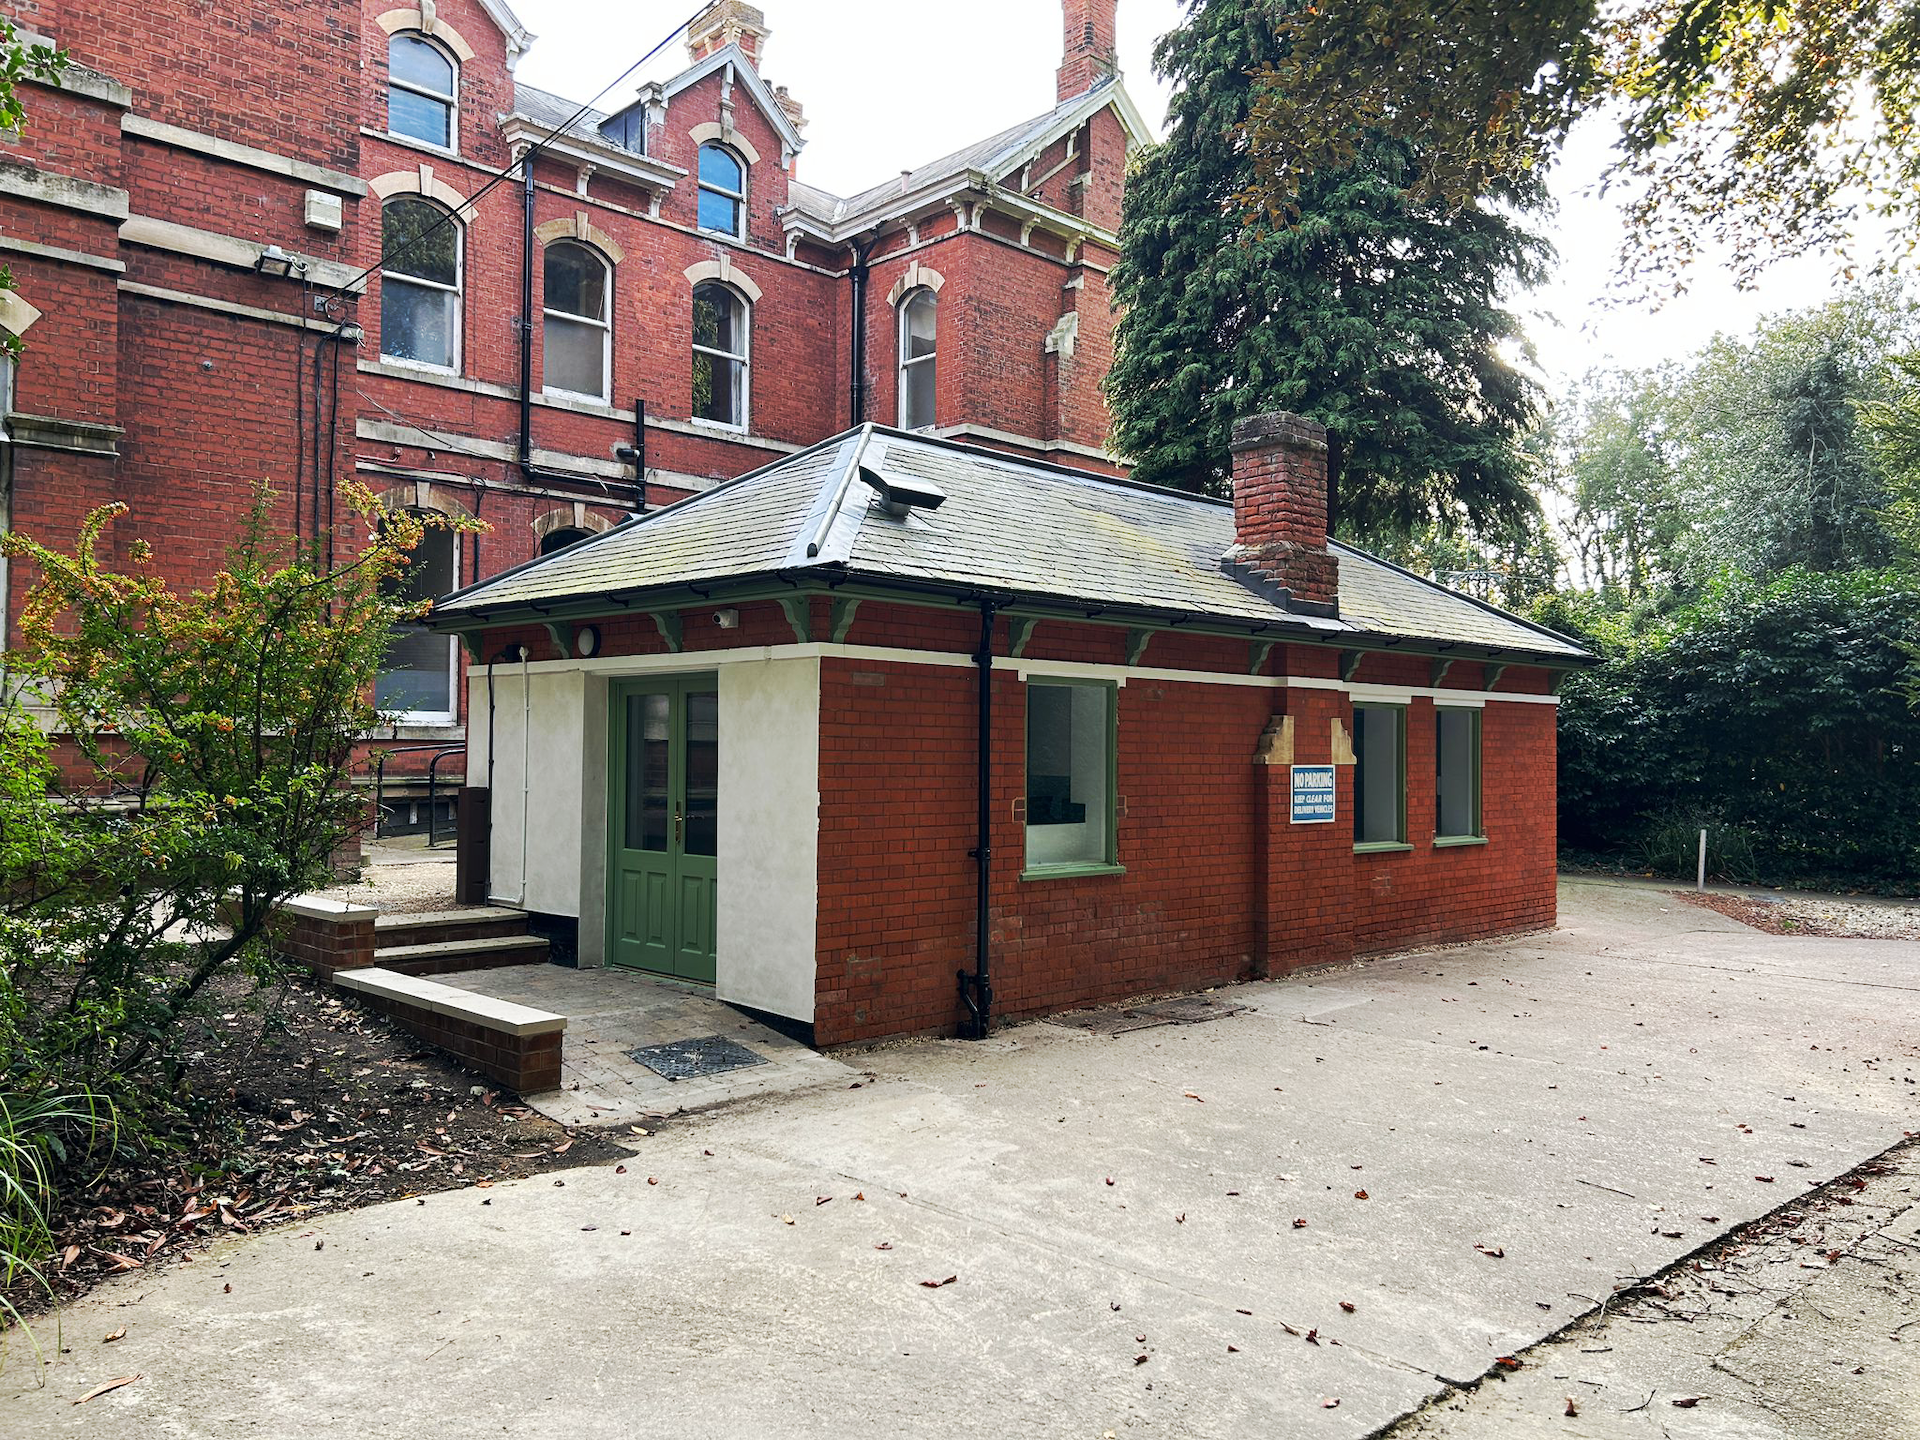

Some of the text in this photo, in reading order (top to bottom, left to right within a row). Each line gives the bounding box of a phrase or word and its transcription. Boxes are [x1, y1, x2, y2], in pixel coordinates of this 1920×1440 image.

[1294, 772, 1332, 788] NO PARKING
[1294, 794, 1333, 803] KEEP CLEAR FOR
